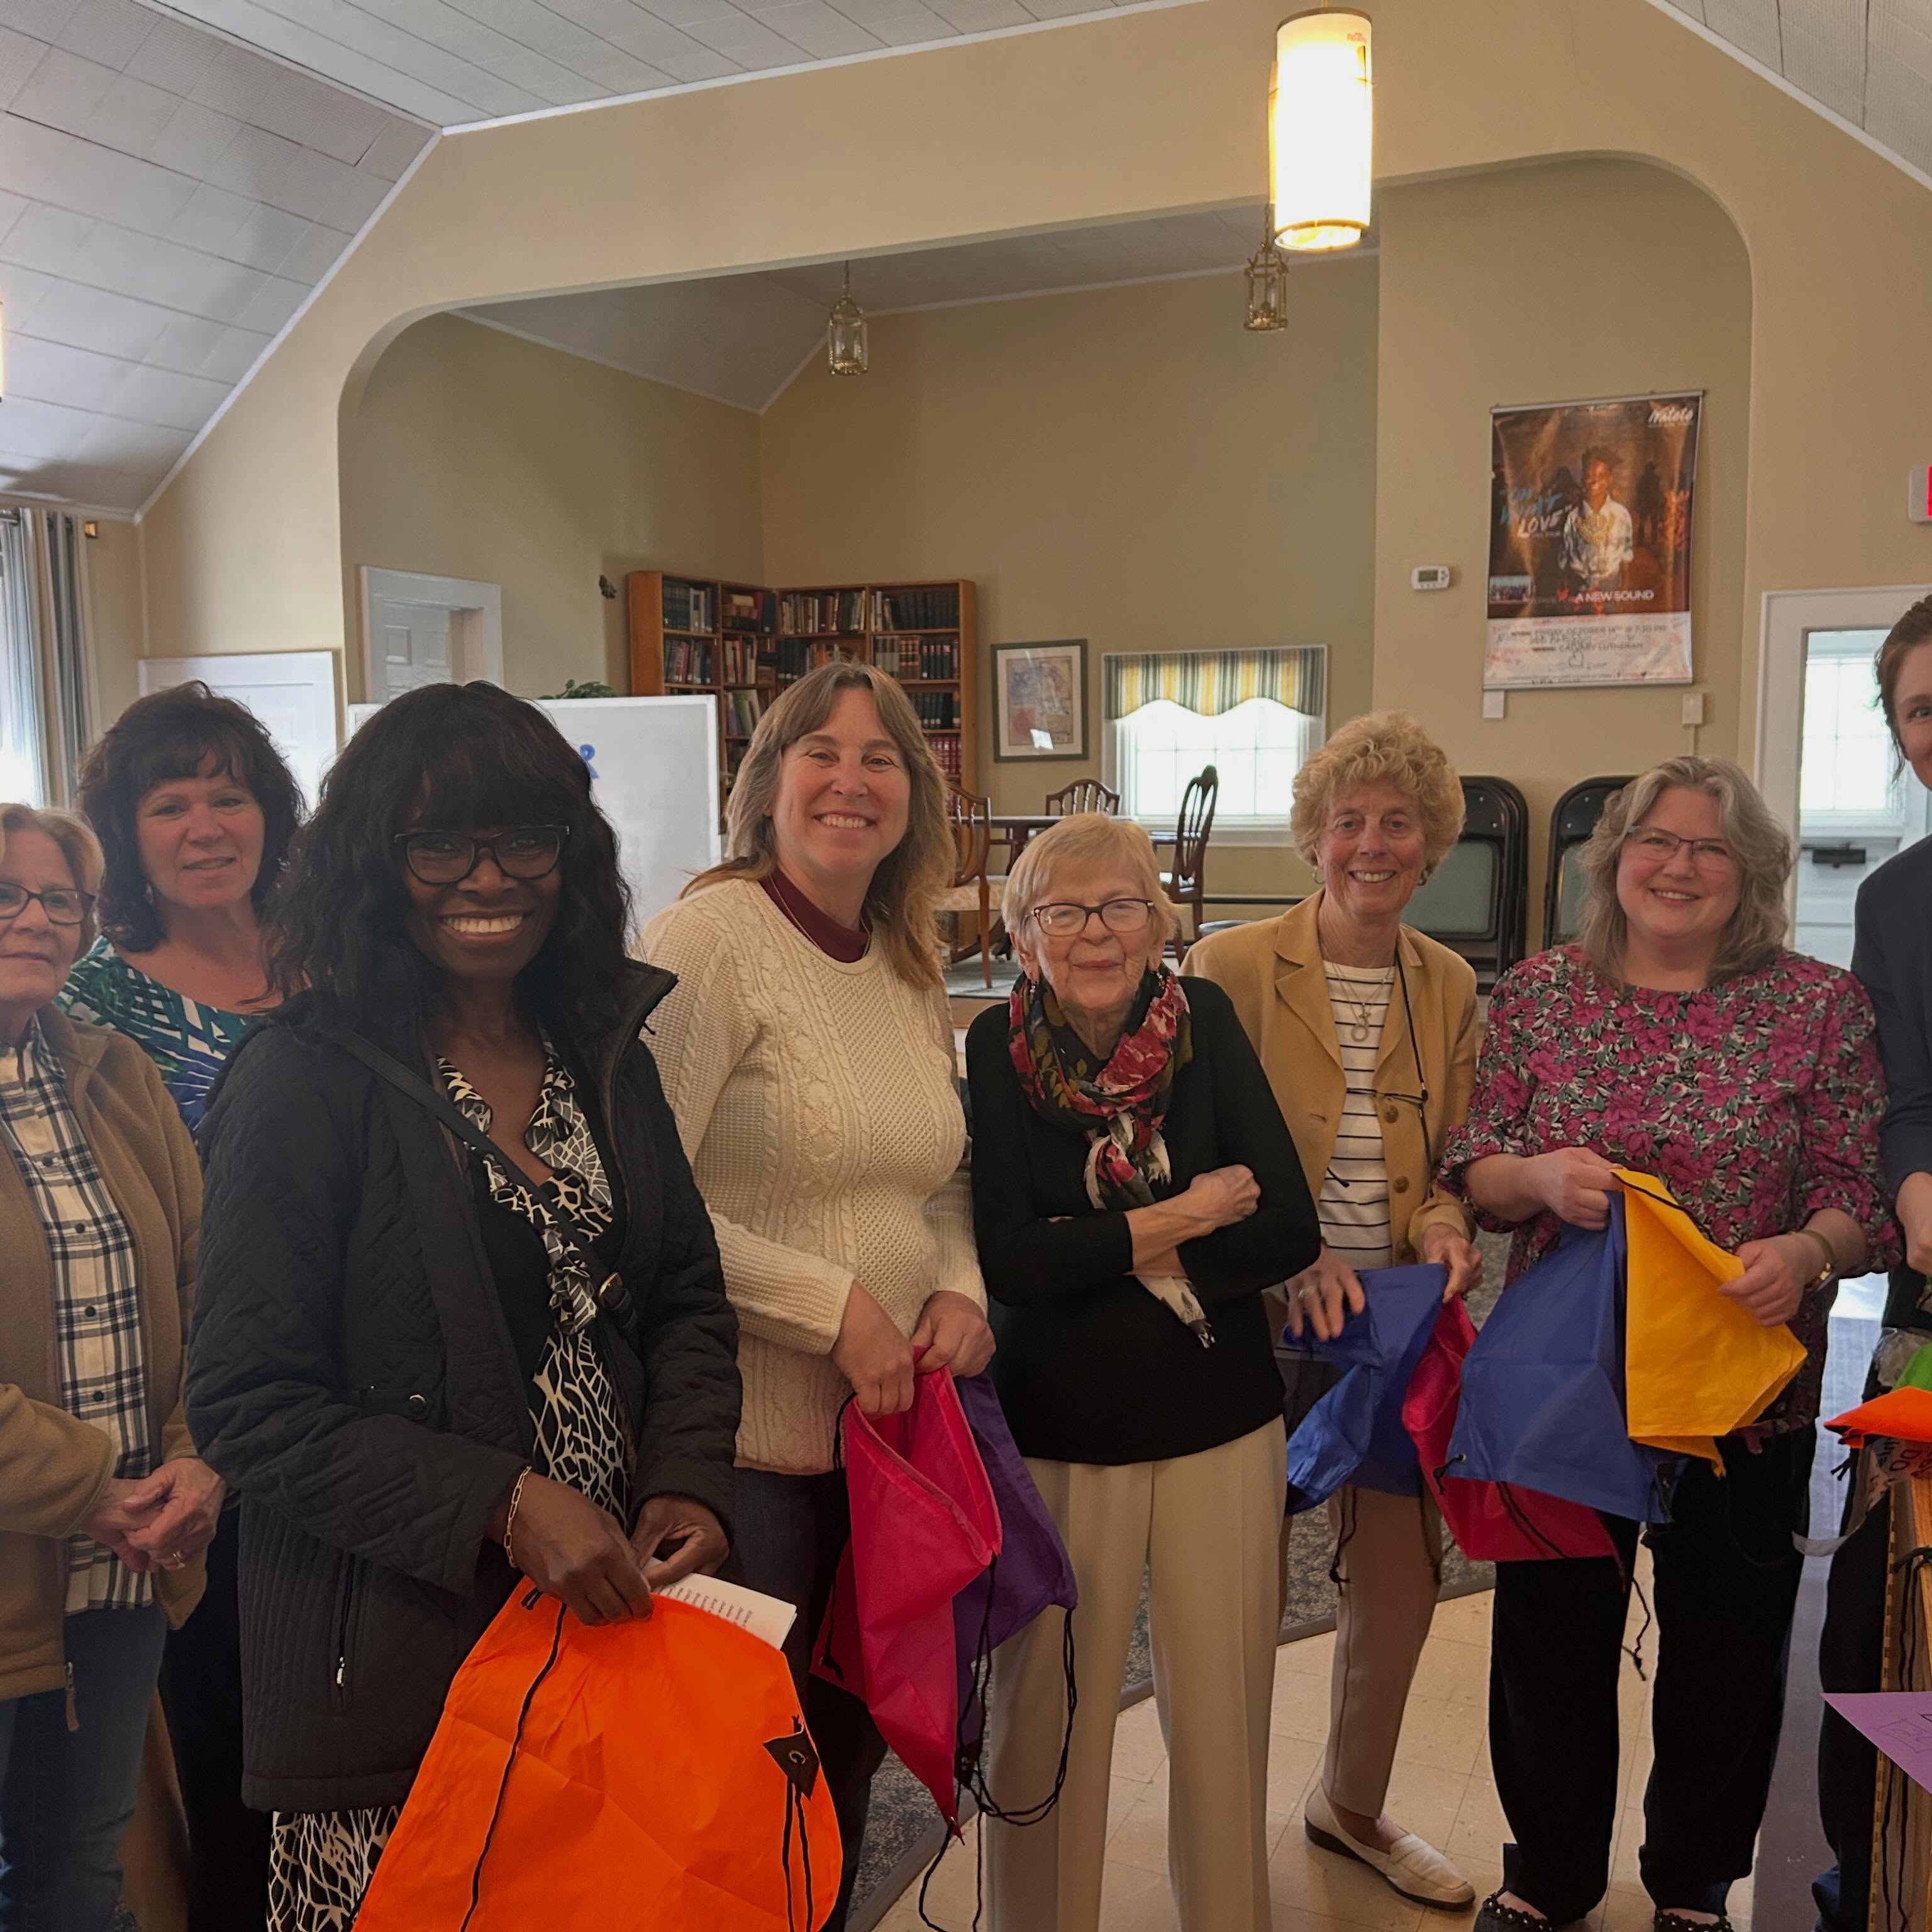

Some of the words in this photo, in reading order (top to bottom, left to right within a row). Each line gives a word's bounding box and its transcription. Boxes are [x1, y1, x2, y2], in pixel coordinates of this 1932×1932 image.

[1576, 592, 1584, 602] A
[1585, 591, 1613, 602] NEW
[1614, 589, 1655, 601] SOUND
[1566, 626, 1606, 635] OCTOBER
[1598, 641, 1643, 651] LUTHERAN
